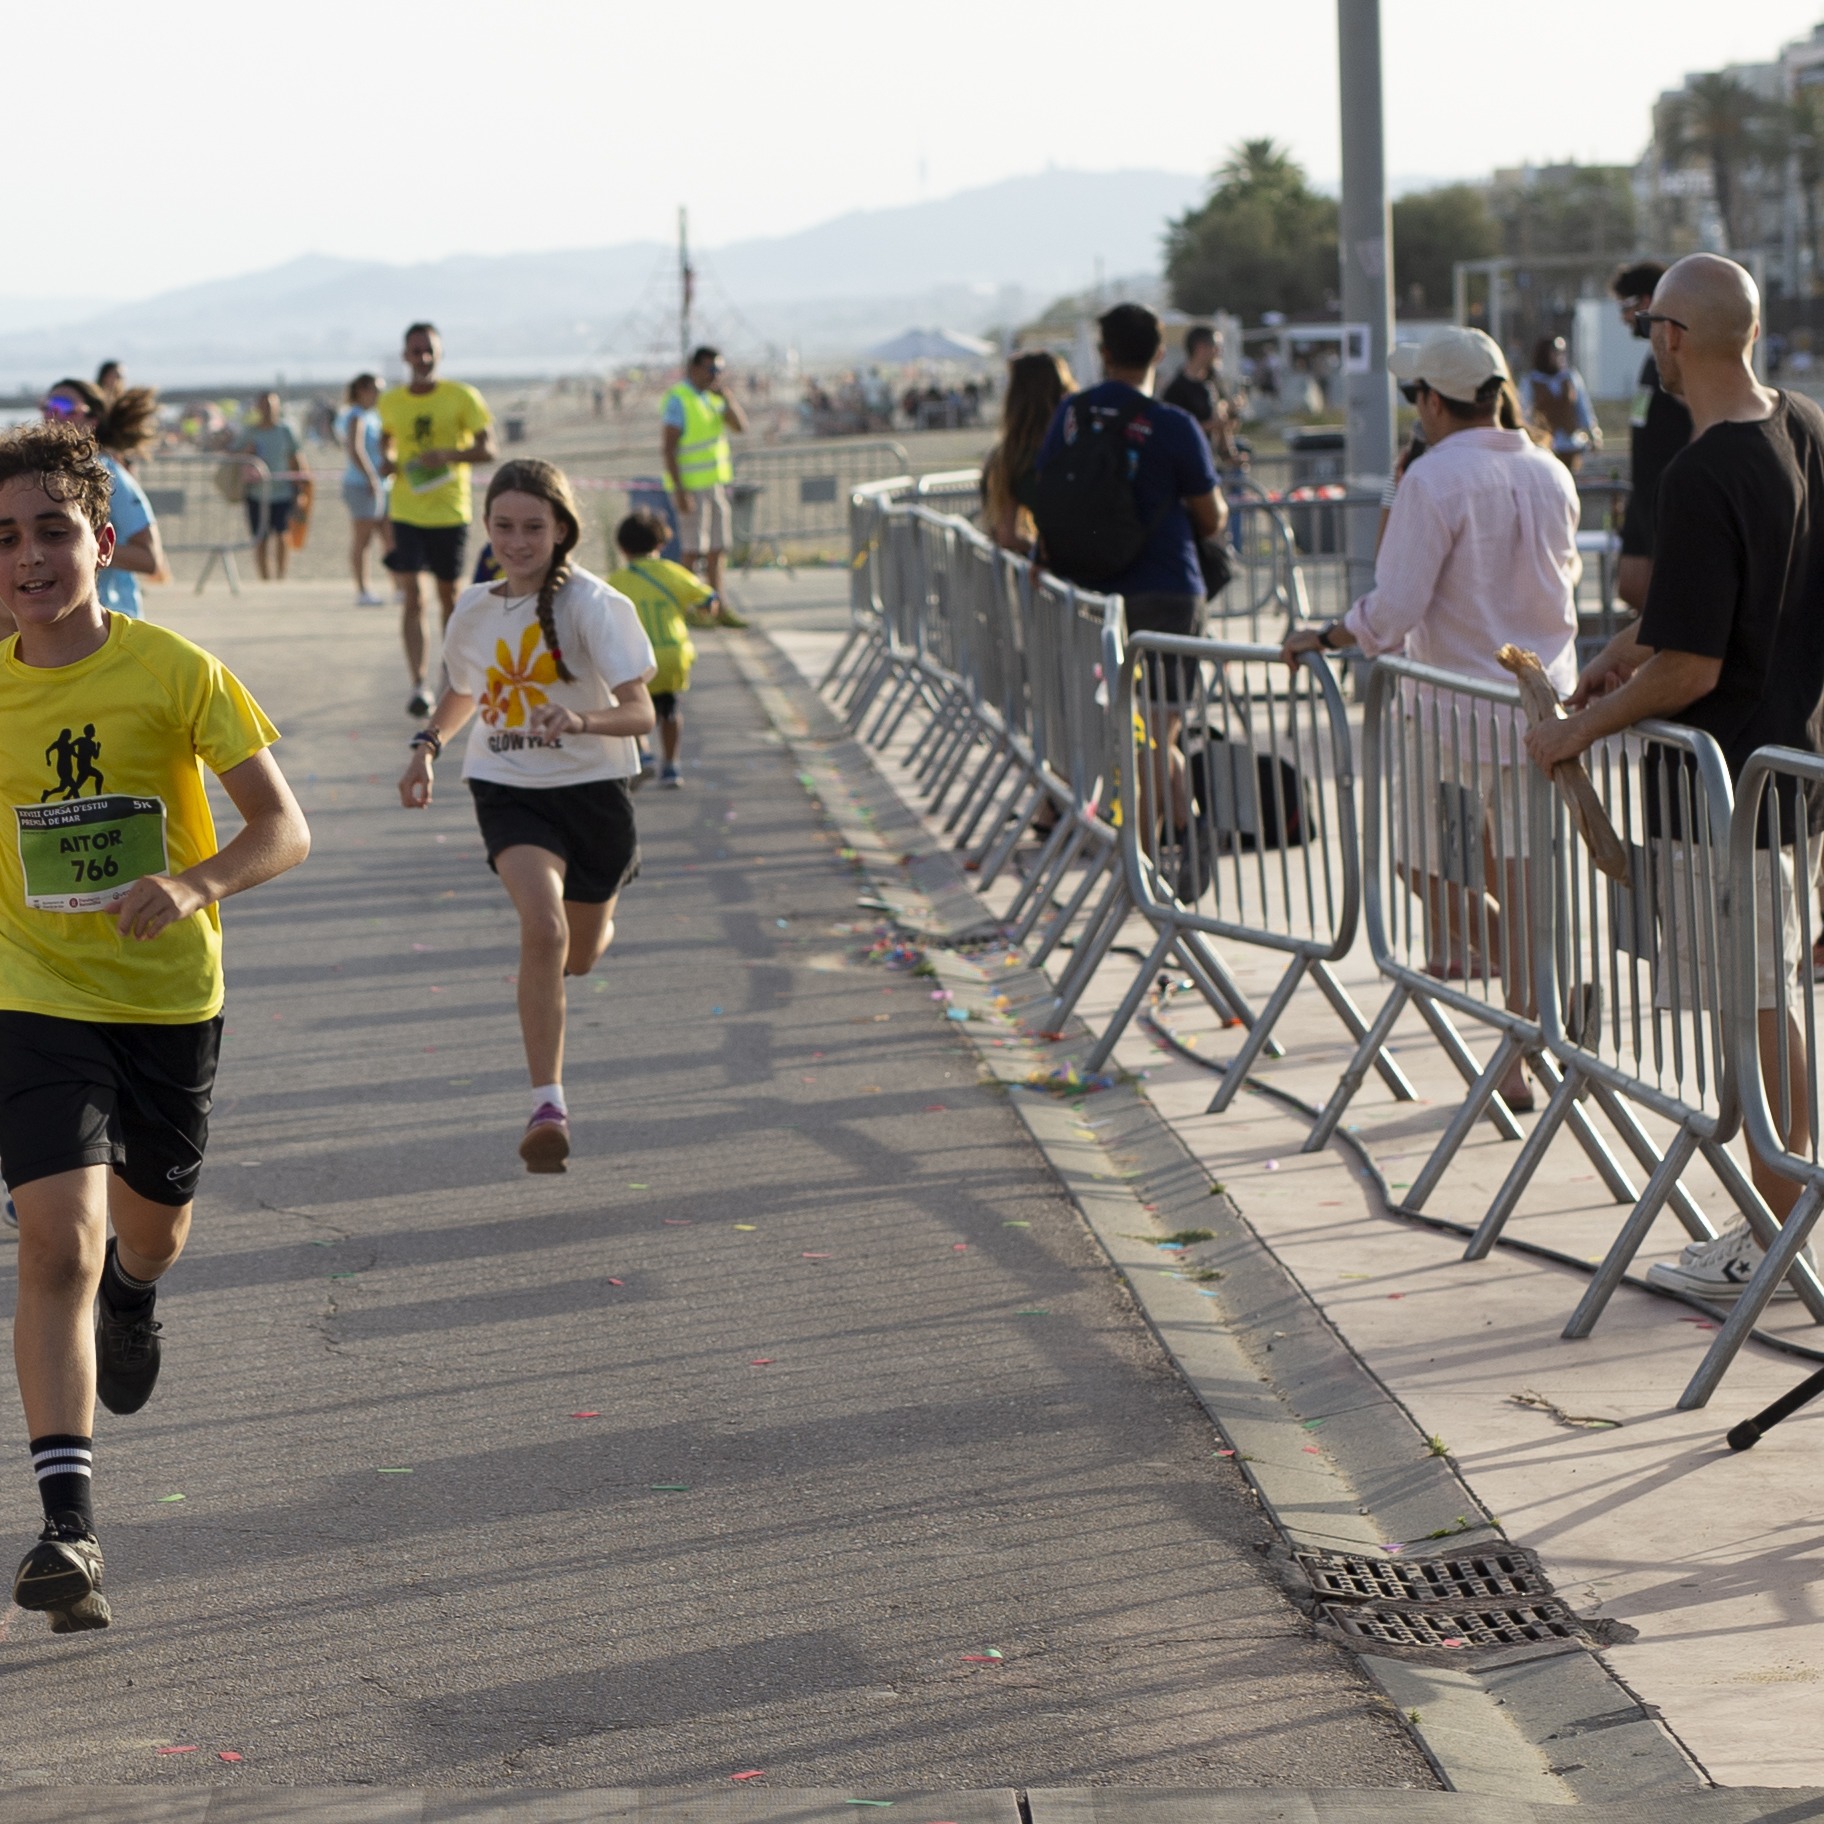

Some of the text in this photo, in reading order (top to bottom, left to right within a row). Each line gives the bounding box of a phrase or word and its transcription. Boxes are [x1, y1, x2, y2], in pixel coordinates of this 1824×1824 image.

[43, 806, 71, 817] CURSA
[73, 801, 108, 813] D'ESTIU
[133, 800, 153, 810] 5K
[48, 817, 60, 826] DE
[61, 815, 81, 824] MAR
[60, 829, 123, 854] AITOR
[71, 855, 119, 882] 766
